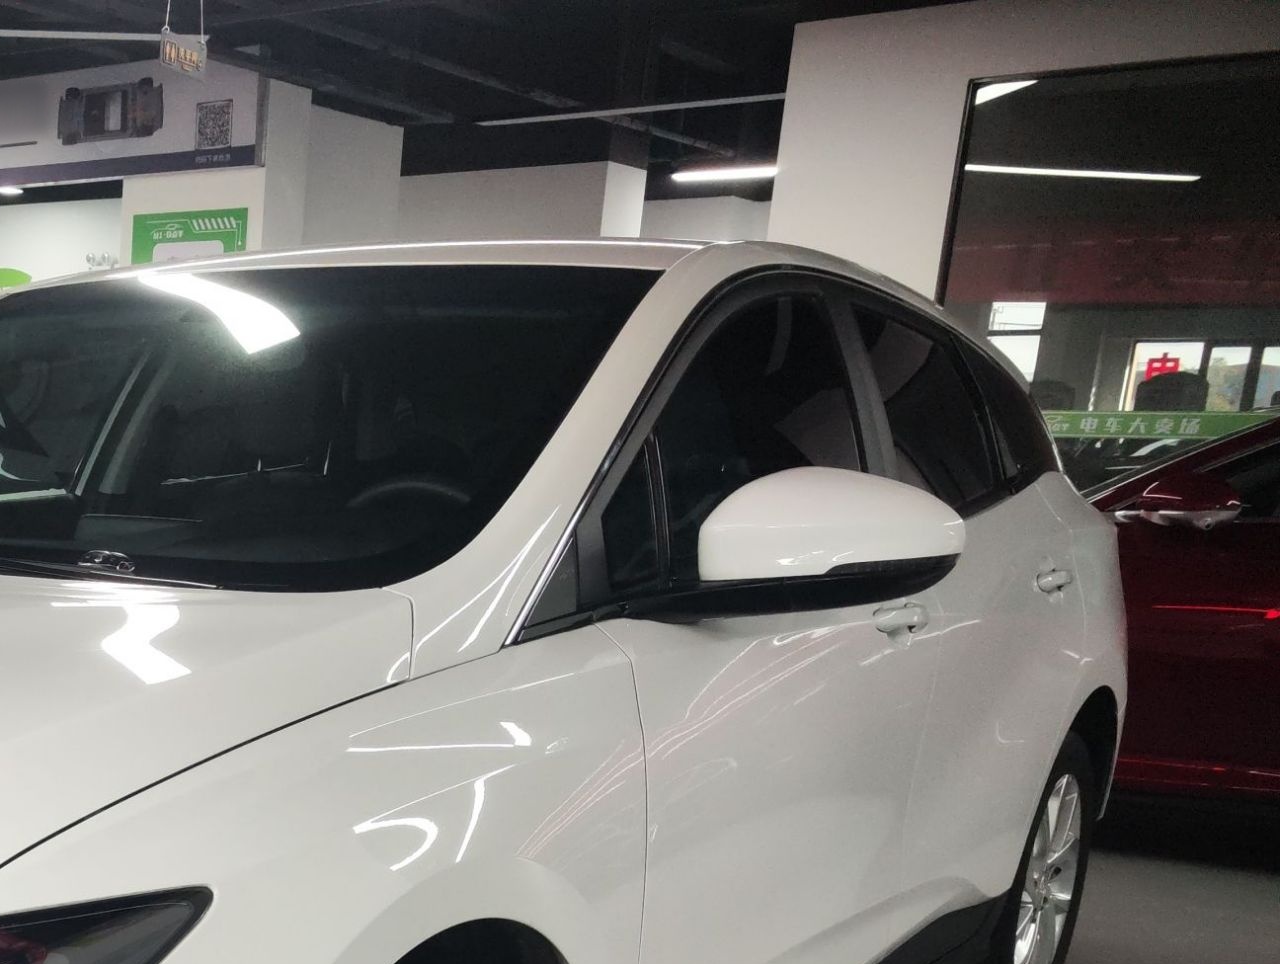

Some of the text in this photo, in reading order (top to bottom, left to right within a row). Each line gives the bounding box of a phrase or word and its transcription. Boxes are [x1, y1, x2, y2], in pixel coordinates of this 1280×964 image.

[1079, 416, 1201, 434] 电车大卖场
